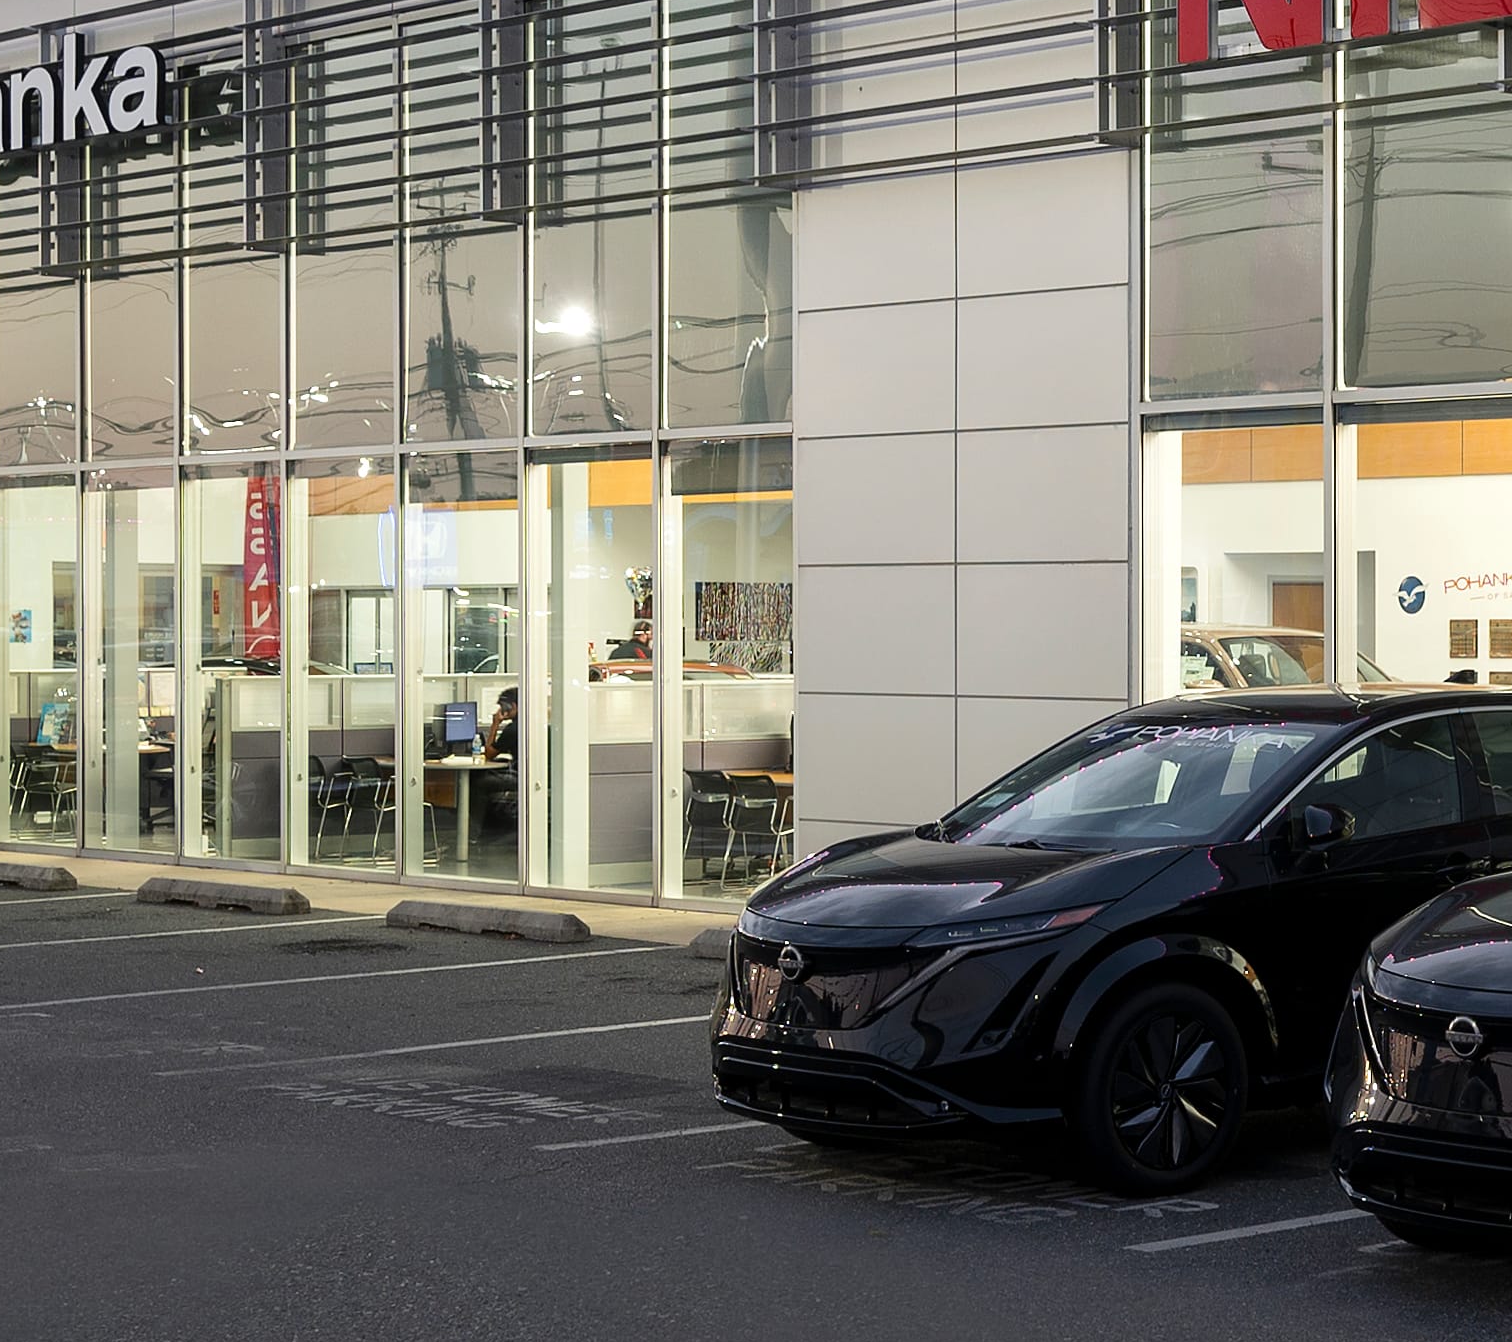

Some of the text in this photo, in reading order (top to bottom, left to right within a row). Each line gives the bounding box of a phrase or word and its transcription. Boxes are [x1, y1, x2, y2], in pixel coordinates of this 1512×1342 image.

[1135, 725, 1288, 749] POHANKA
[237, 1082, 538, 1129] PARKING
[690, 1158, 1080, 1225] PARKING
